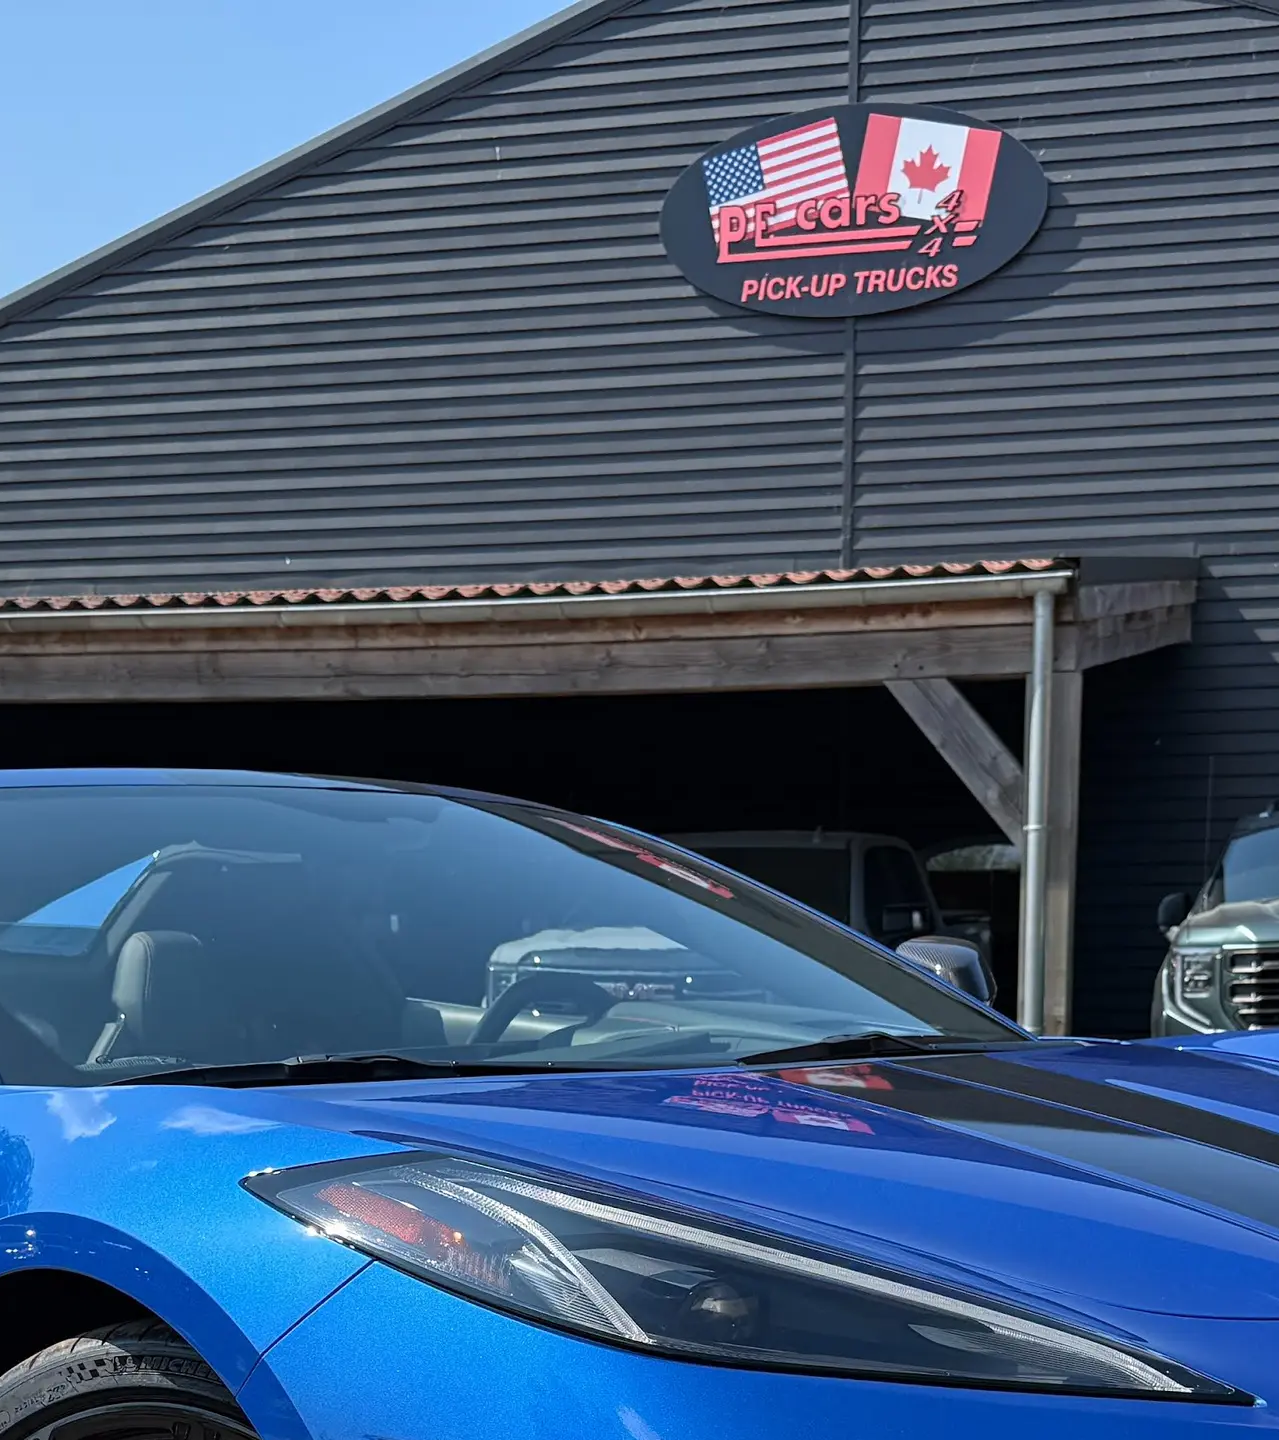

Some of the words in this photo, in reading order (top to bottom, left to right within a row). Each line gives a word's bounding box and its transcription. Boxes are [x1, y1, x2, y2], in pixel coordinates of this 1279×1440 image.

[796, 192, 902, 231] cars
[741, 273, 847, 303] PICK-UP
[853, 263, 958, 295] TRUCKS
